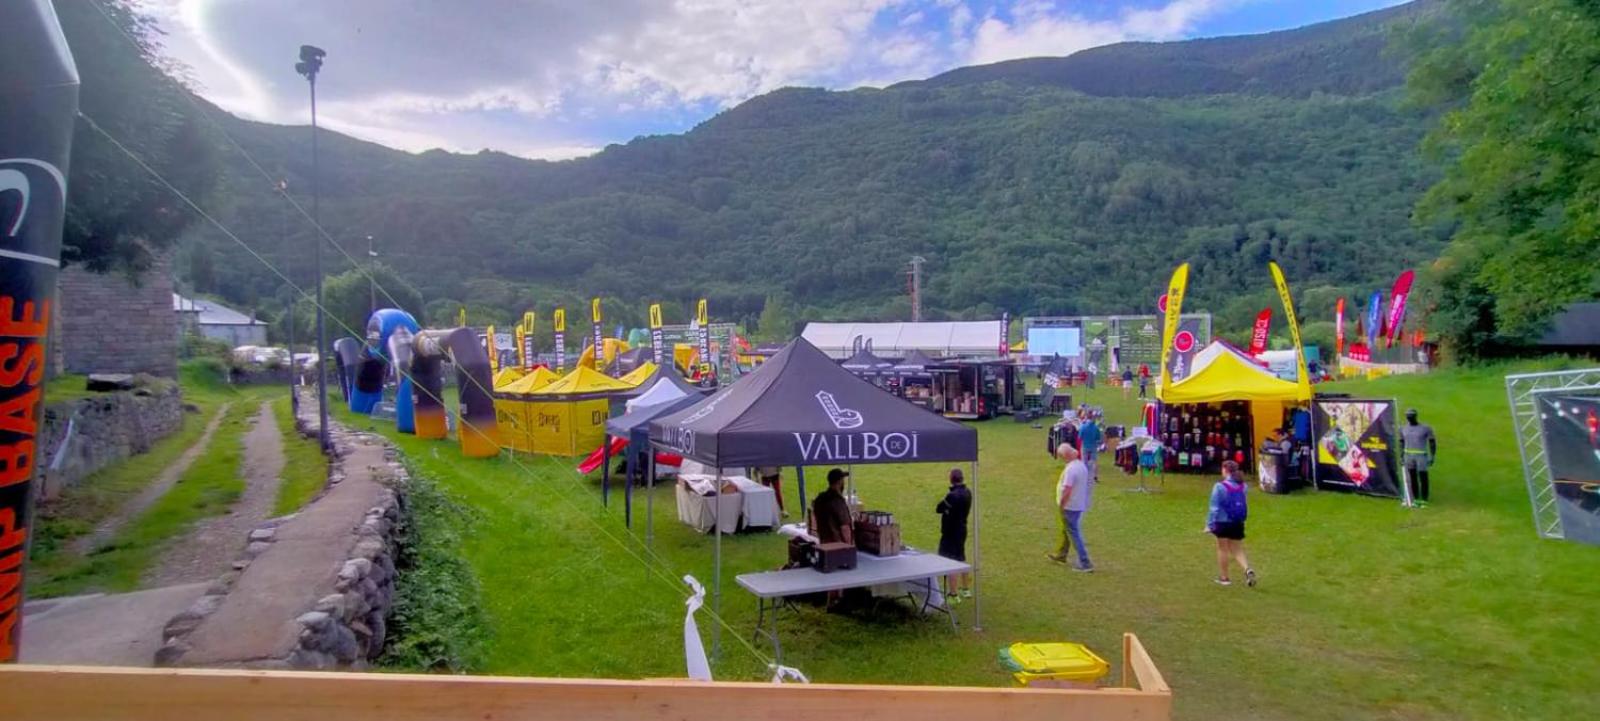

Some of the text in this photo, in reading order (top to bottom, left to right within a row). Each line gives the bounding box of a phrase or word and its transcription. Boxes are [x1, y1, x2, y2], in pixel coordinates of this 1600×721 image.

[0, 296, 51, 487] BASE
[792, 432, 859, 460] VALL
[890, 440, 902, 449] DE
